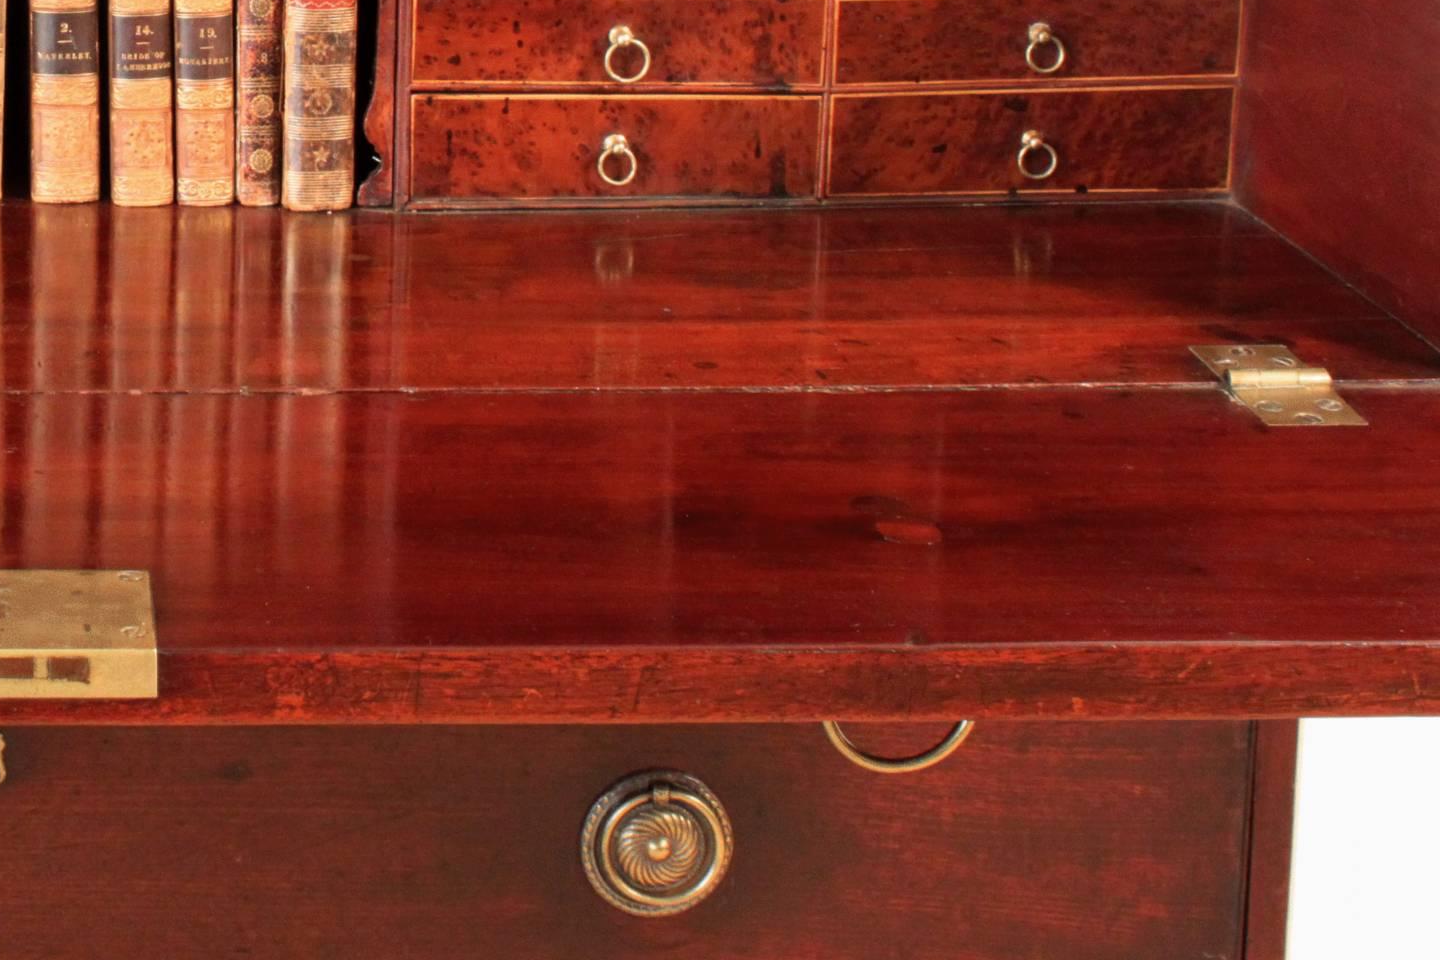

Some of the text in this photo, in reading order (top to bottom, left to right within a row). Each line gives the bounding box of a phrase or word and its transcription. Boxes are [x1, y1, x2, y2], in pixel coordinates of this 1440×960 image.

[59, 22, 73, 34] 2.
[135, 24, 154, 36] 14.
[199, 27, 218, 39] 19.
